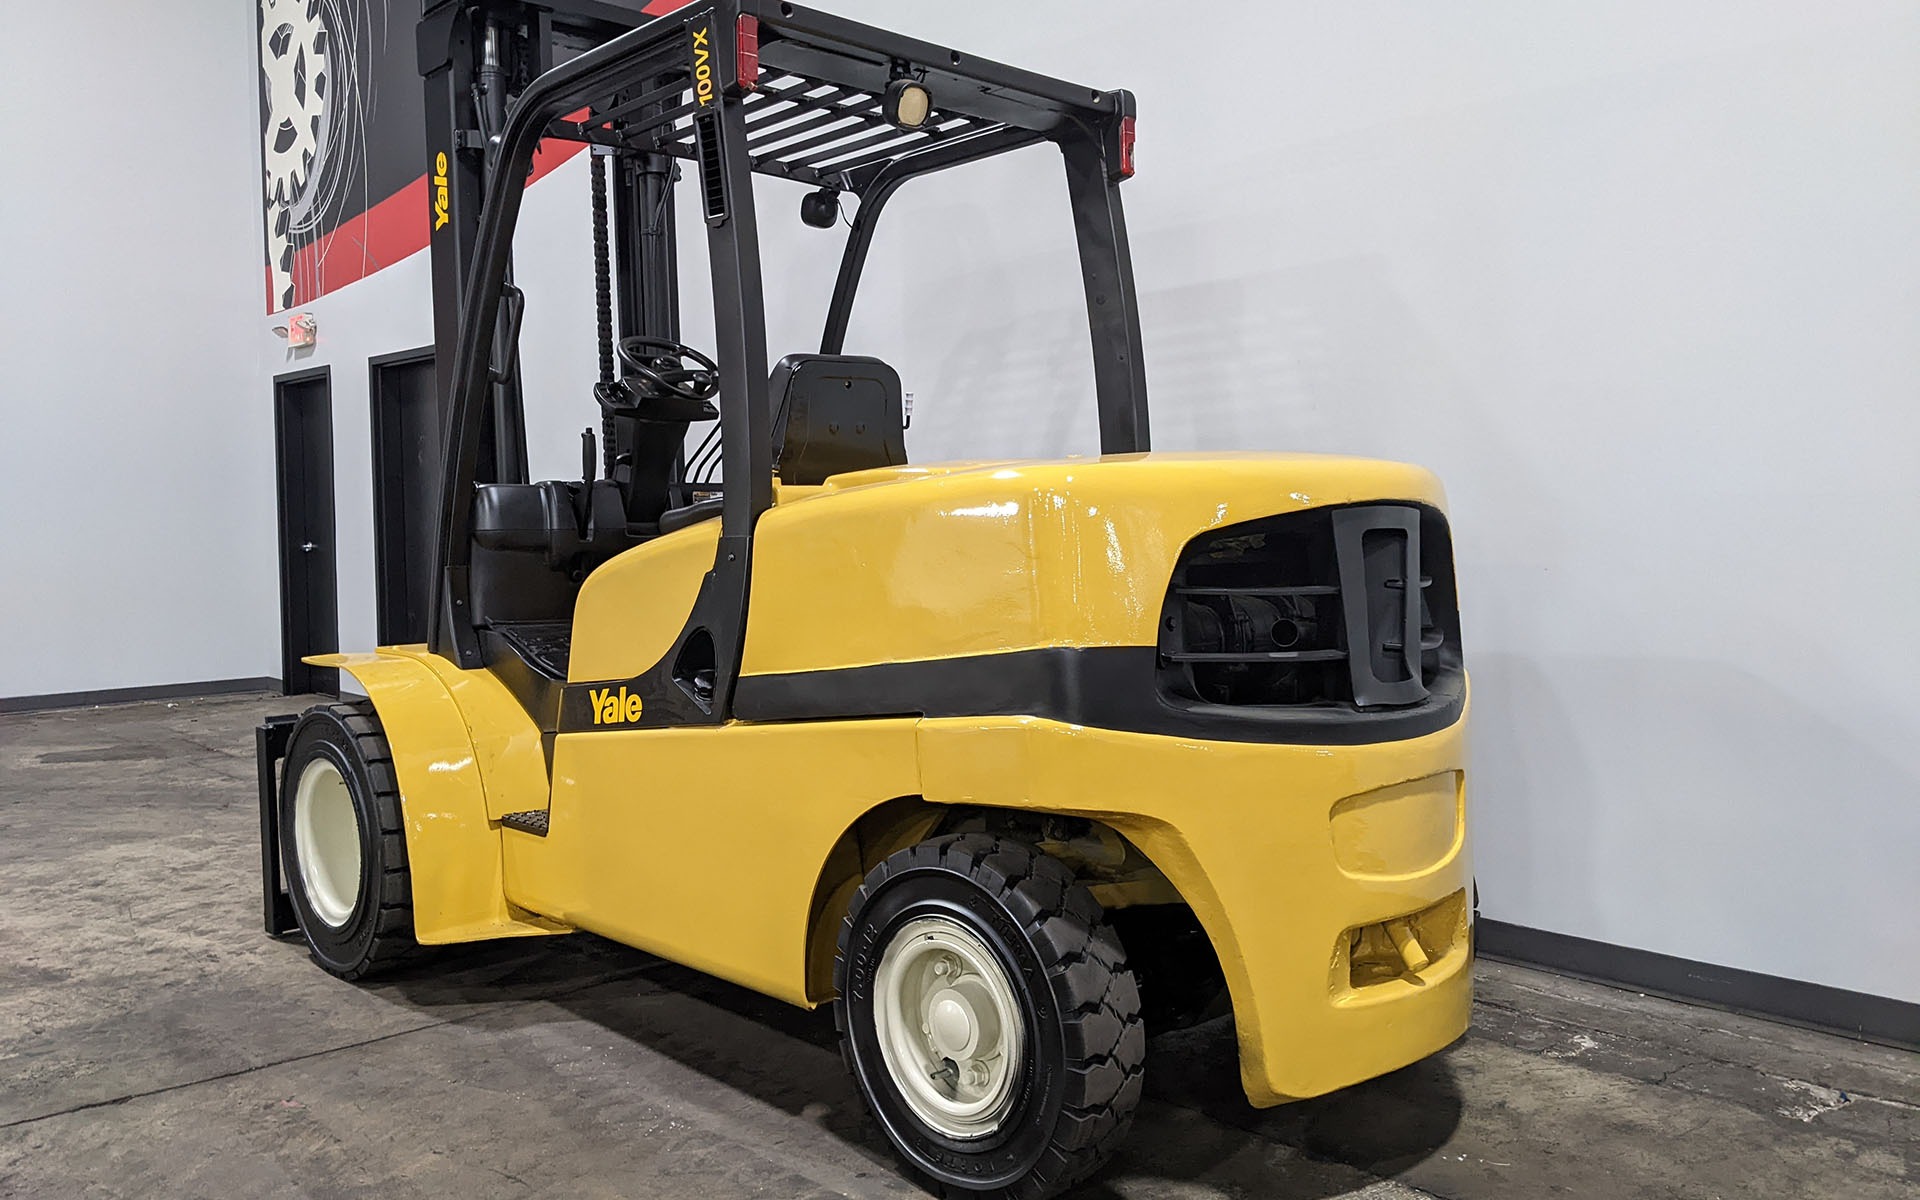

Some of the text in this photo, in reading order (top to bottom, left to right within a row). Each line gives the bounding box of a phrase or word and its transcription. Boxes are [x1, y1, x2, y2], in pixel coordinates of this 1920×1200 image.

[692, 27, 713, 106] 100VX
[433, 151, 449, 231] Yale
[589, 686, 643, 725] Yale
